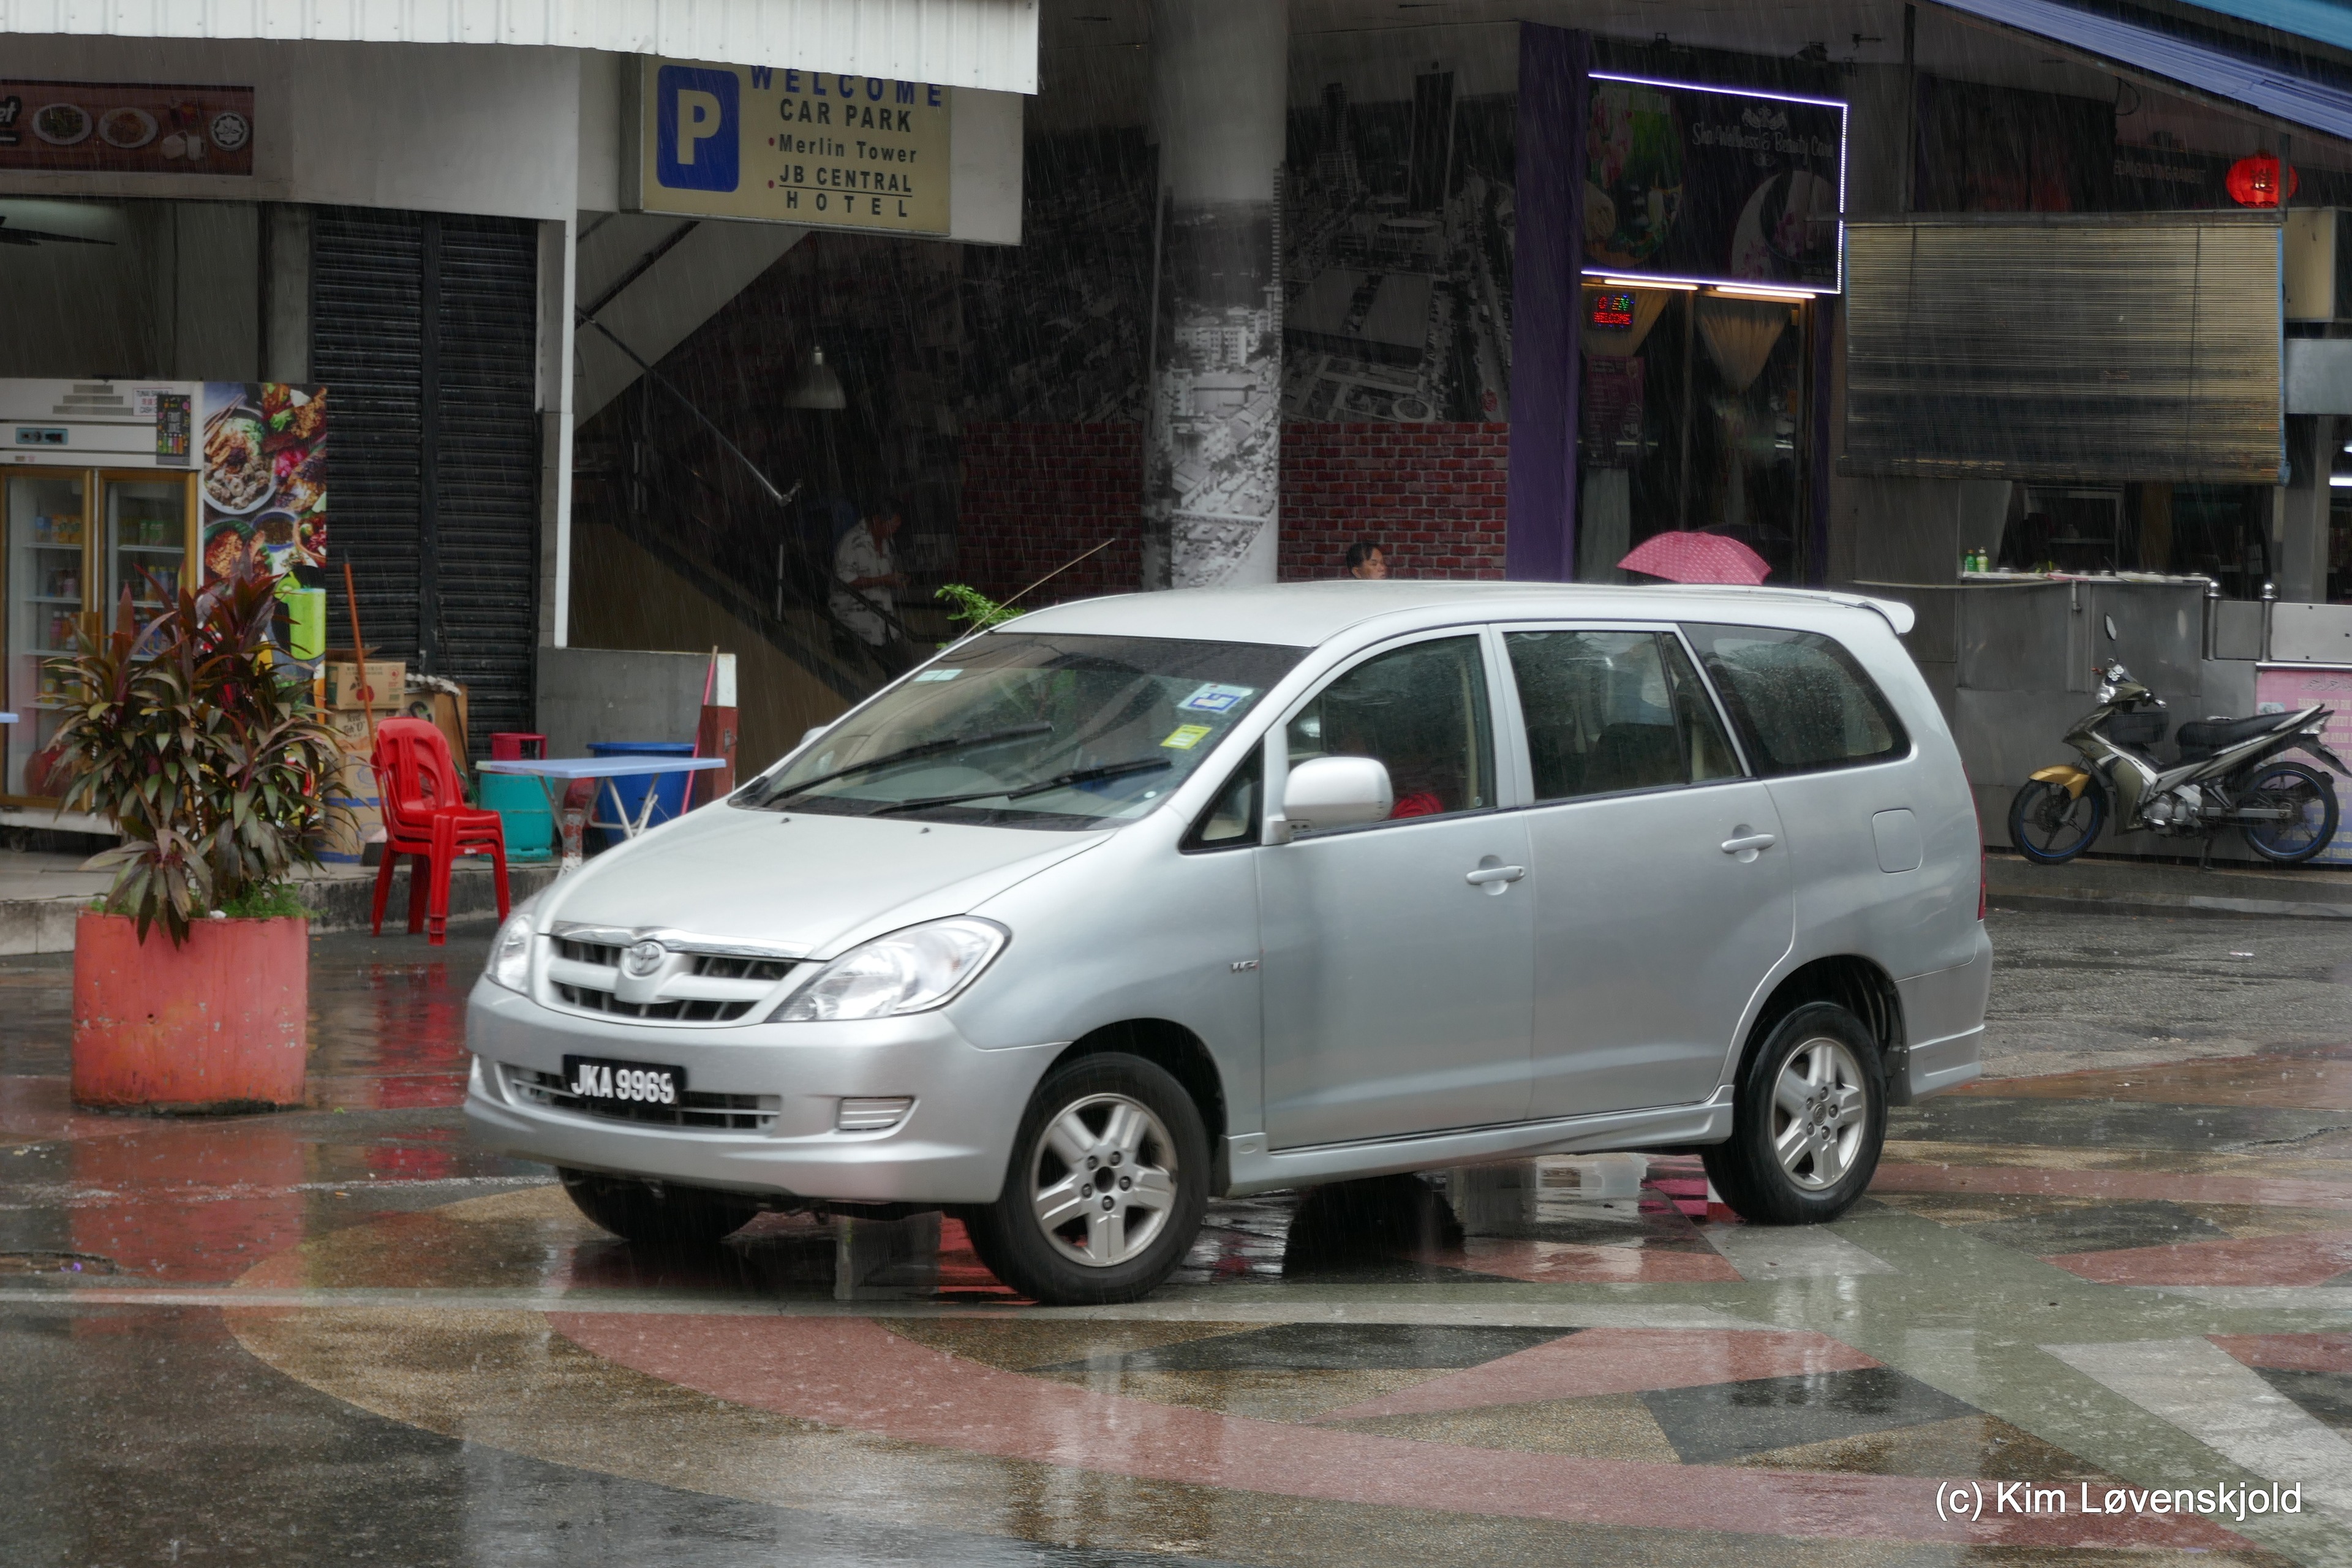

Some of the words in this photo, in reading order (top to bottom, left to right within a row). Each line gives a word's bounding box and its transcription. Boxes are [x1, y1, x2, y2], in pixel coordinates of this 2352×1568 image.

[750, 65, 942, 107] WELCOME
[677, 89, 722, 165] P
[780, 98, 831, 124] CAR
[845, 105, 911, 132] PARK
[778, 134, 845, 157] Merlin
[856, 140, 917, 164] Tower
[779, 164, 804, 184] JB
[816, 167, 912, 193] CENTRAL
[786, 190, 908, 217] HOTEL
[1597, 295, 1630, 311] OEN
[570, 1064, 614, 1098] JKA
